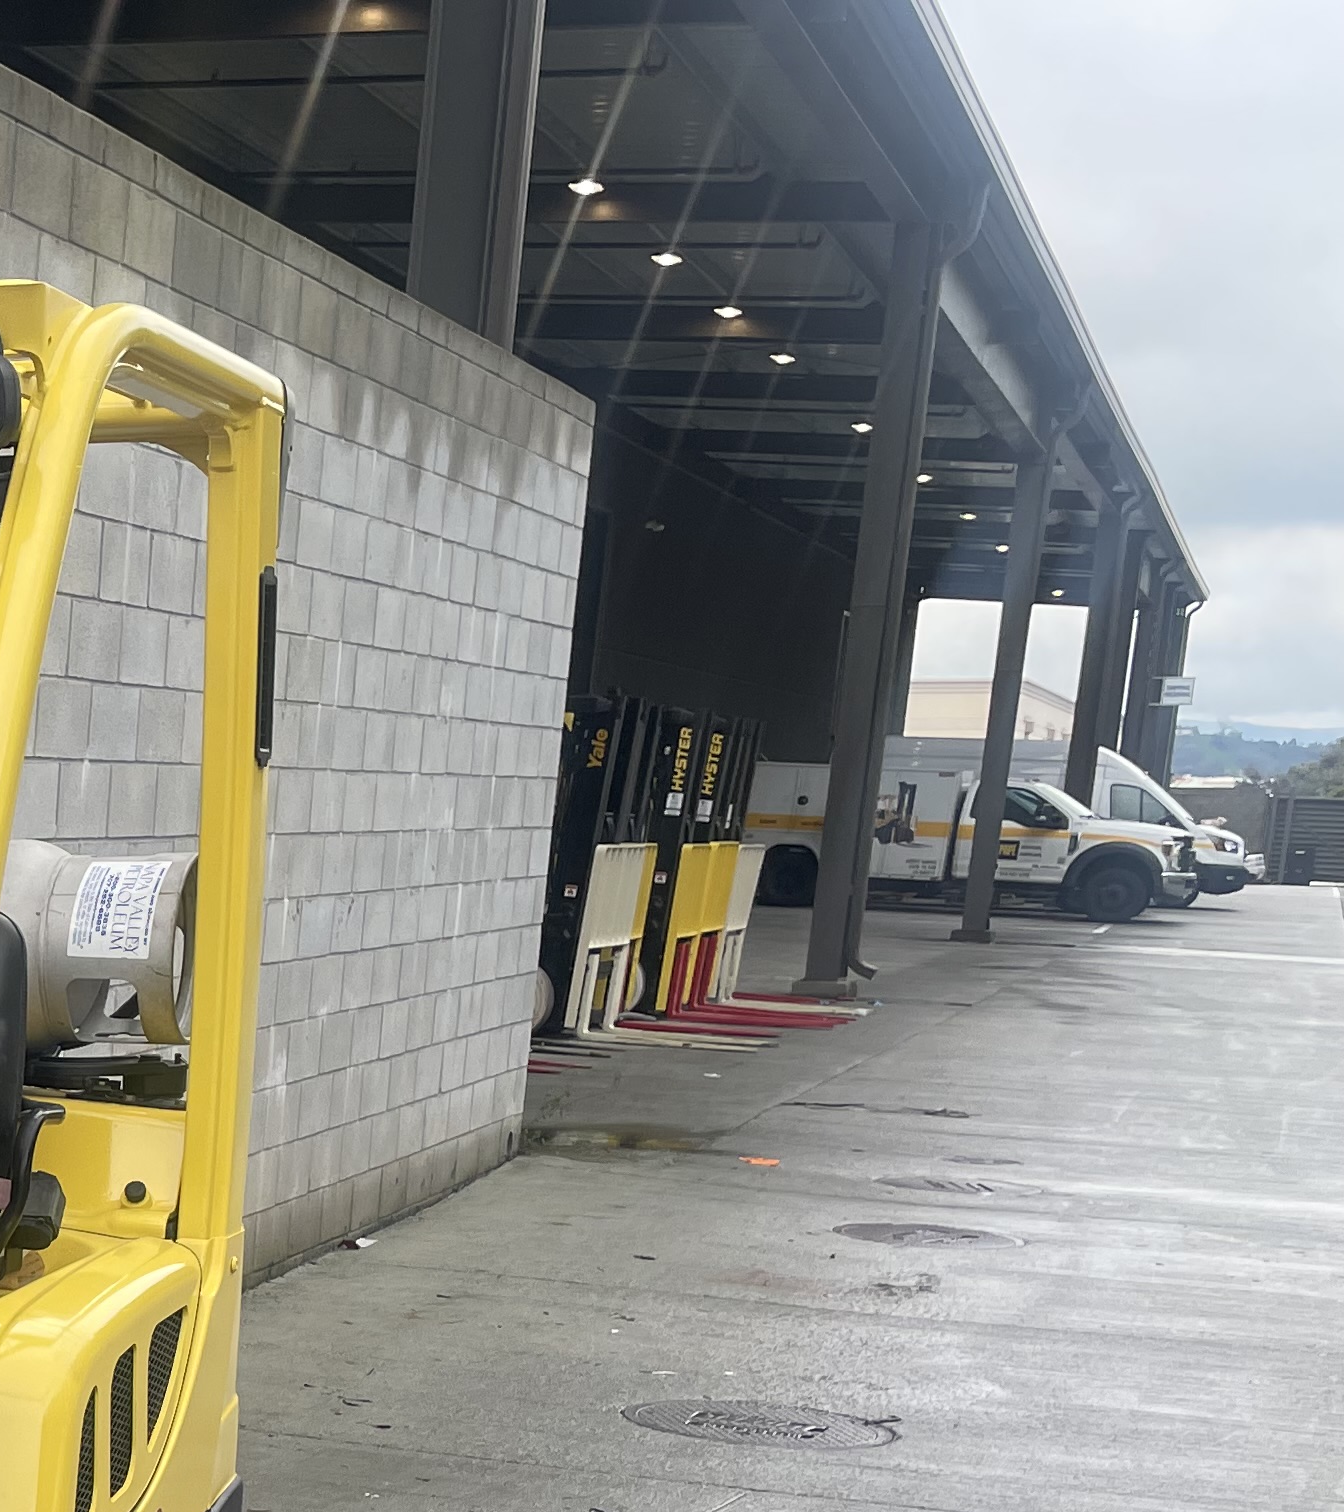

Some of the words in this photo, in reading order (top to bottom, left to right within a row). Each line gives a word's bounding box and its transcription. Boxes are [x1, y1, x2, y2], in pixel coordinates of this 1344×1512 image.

[586, 728, 609, 768] Yale
[671, 726, 694, 791] HYSTER
[701, 732, 725, 795] HYSTER
[109, 864, 144, 951] PETROLEUM
[136, 862, 160, 891] NAPA
[123, 895, 147, 956] VALLEY
